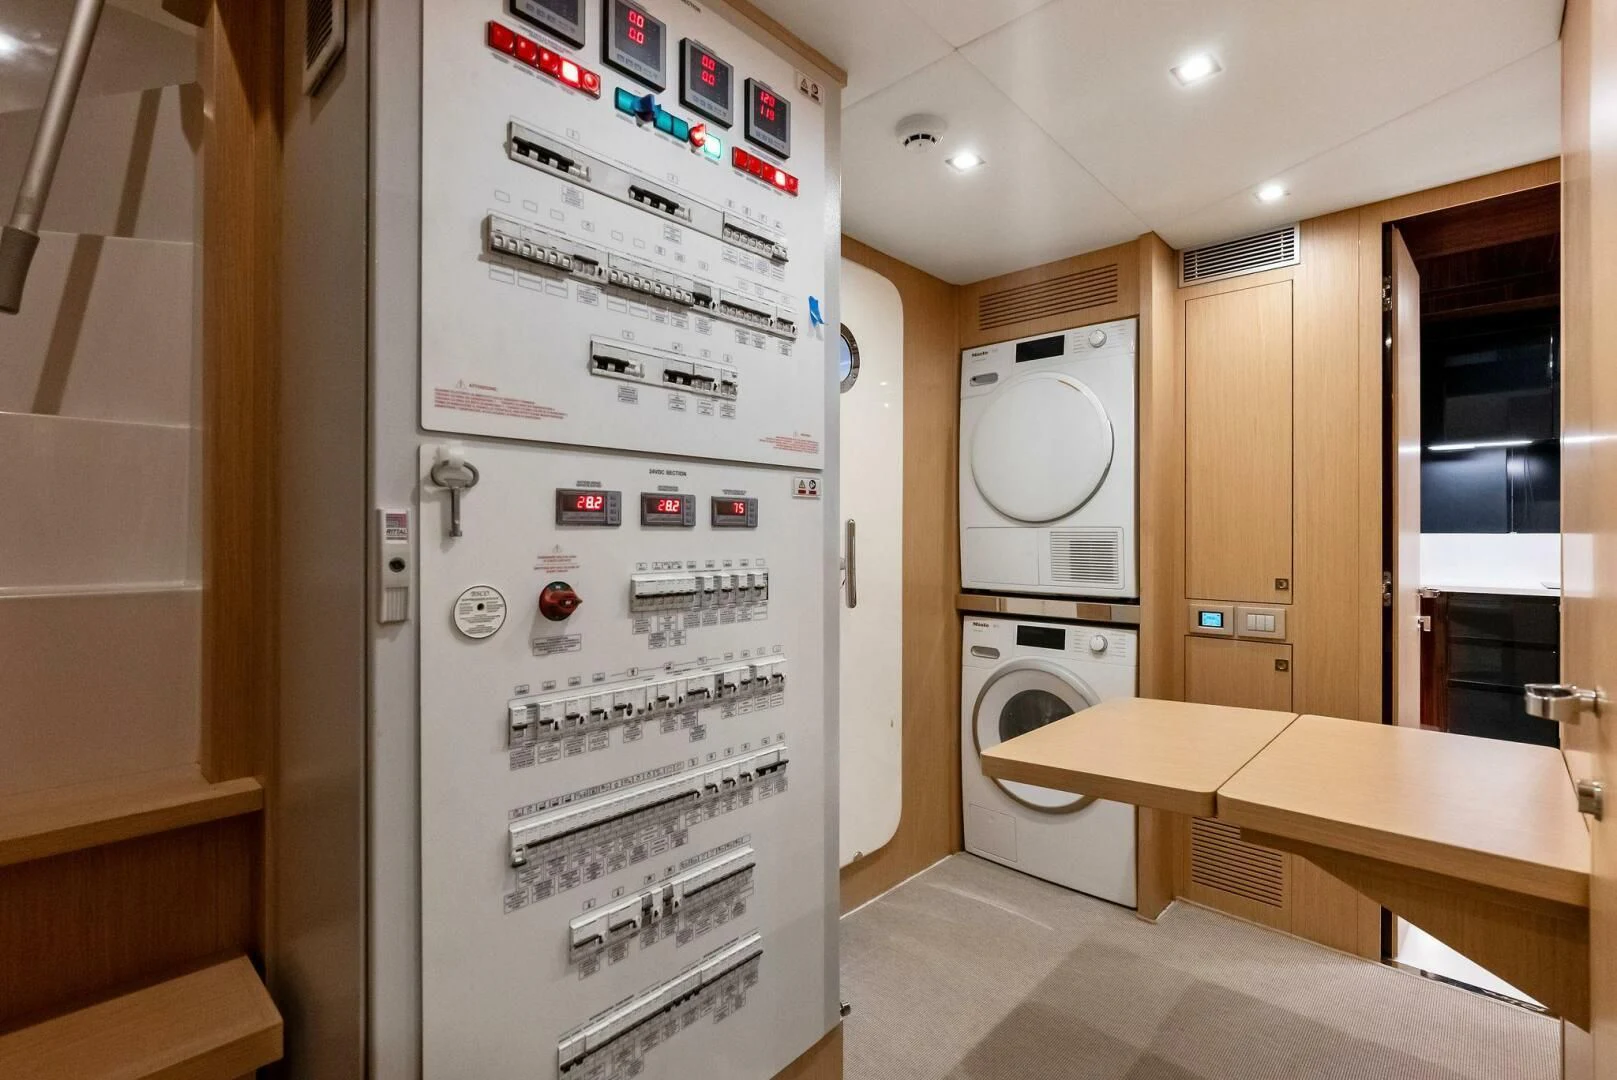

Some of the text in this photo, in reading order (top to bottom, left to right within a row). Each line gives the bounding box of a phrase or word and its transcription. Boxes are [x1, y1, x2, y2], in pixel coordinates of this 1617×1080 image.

[577, 495, 602, 510] 28.2
[658, 499, 680, 513] 28.2
[733, 502, 744, 515] 75
